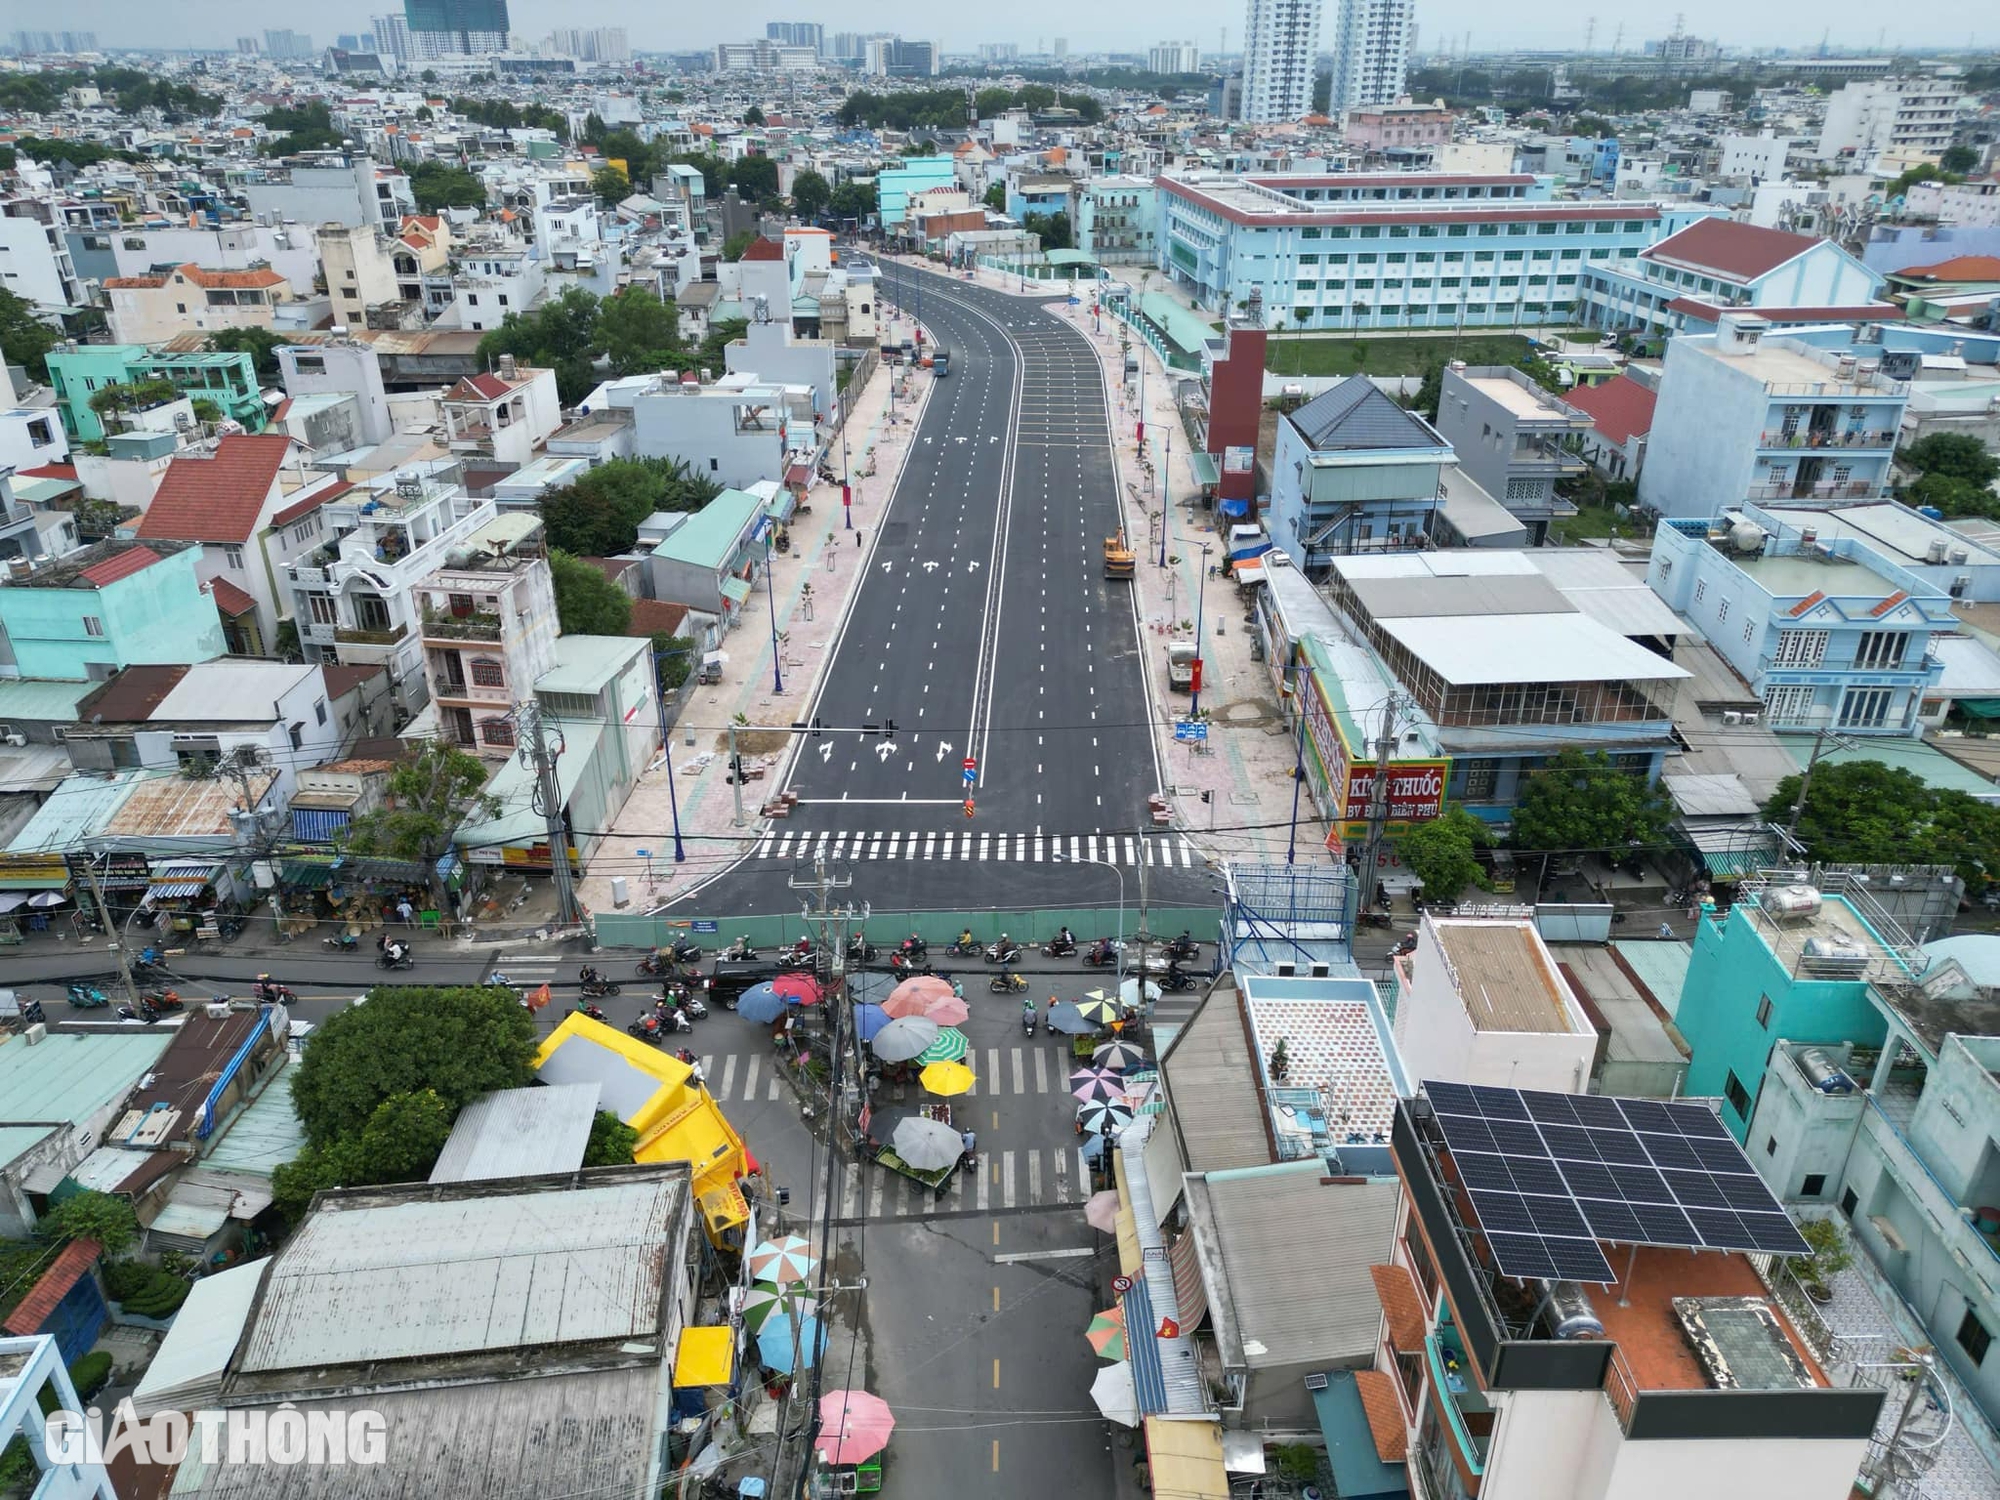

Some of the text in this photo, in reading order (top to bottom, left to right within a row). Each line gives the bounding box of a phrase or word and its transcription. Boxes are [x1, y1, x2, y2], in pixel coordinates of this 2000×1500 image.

[1393, 769, 1441, 796] THUỐC
[1347, 805, 1361, 818] BV
[1416, 799, 1438, 816] PHỦ
